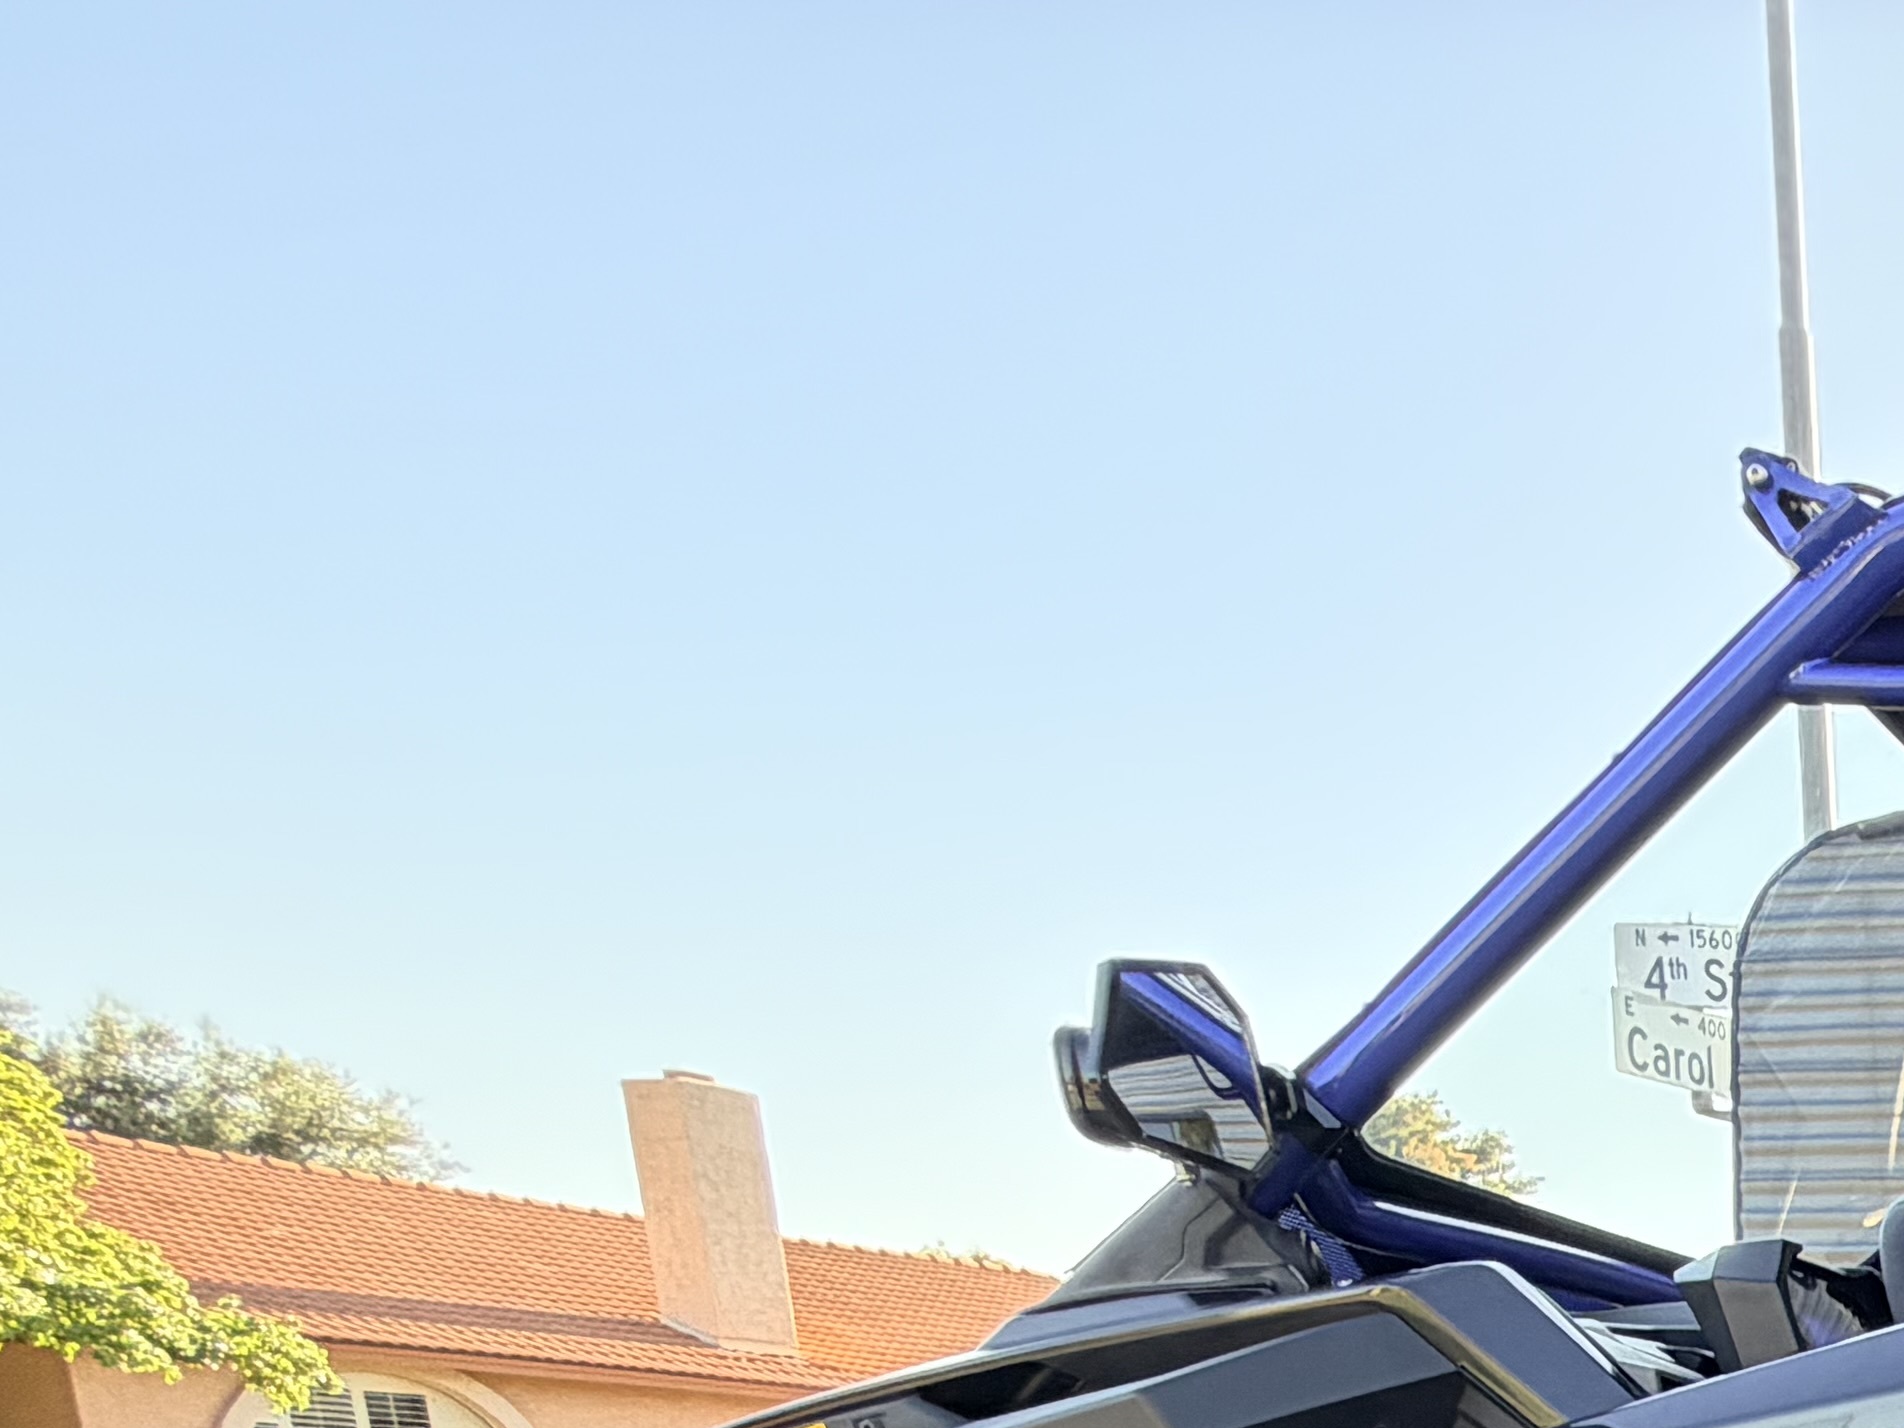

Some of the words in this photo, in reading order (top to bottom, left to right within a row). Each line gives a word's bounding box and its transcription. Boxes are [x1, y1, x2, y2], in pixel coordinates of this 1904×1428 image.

[1635, 928, 1646, 947] N
[1644, 956, 1688, 1001] 4th
[1704, 958, 1734, 1002] S
[1624, 995, 1635, 1017] E
[1697, 1016, 1727, 1041] 400
[1628, 1026, 1715, 1089] Carol
